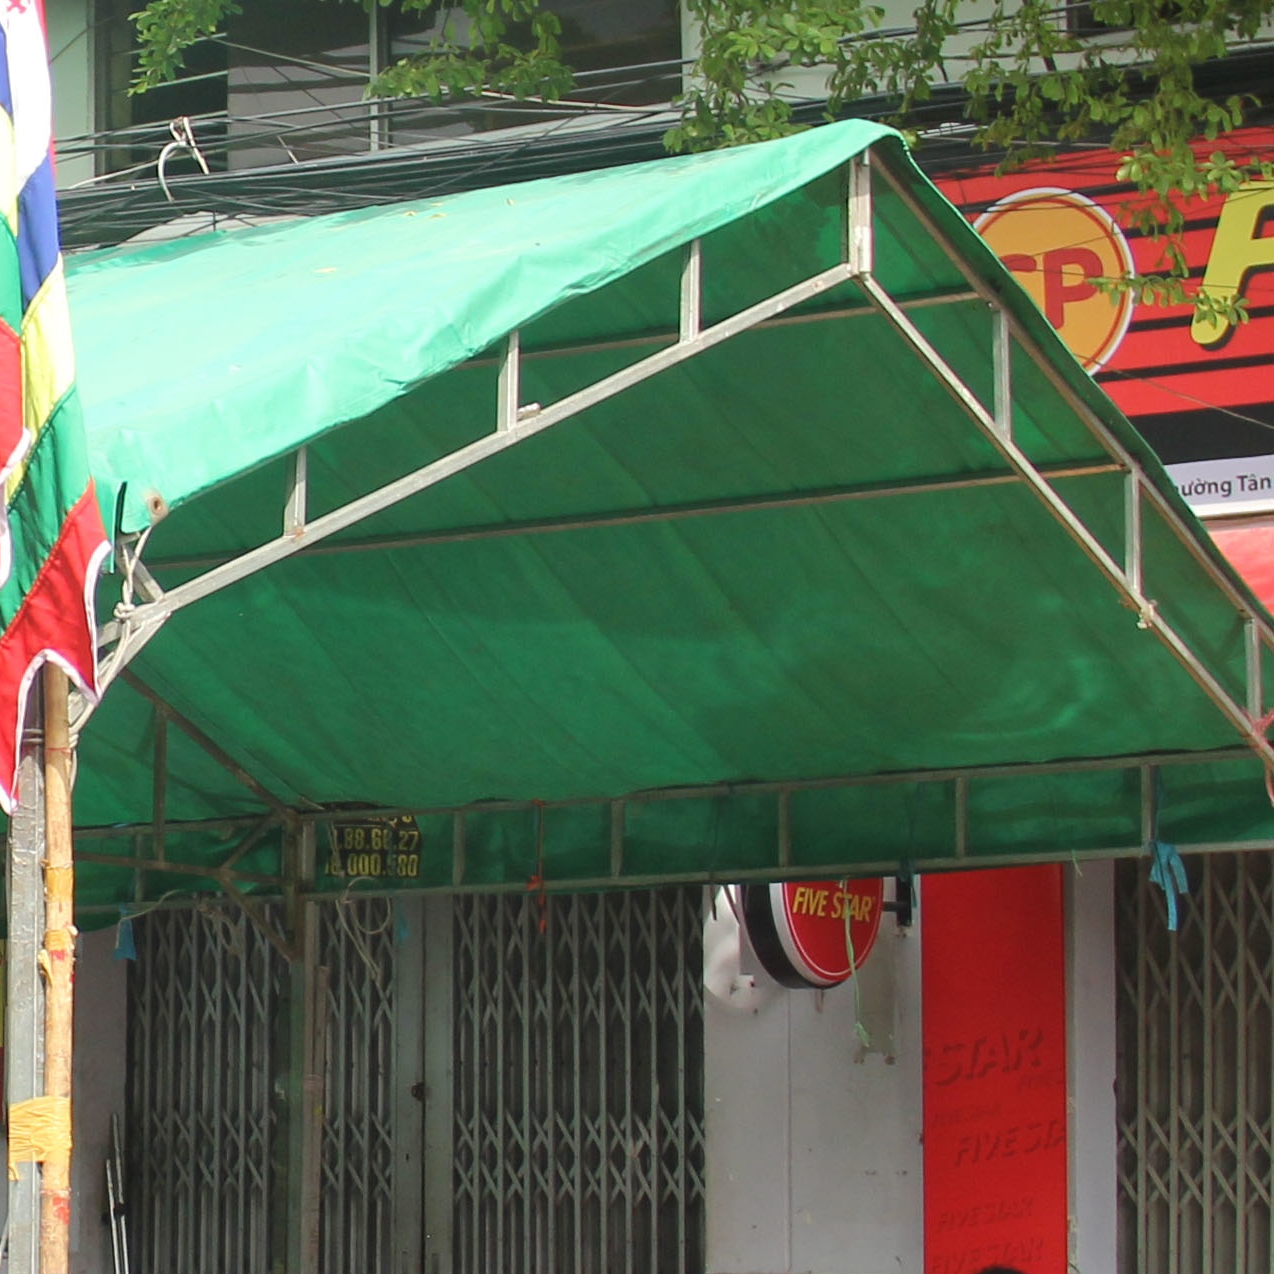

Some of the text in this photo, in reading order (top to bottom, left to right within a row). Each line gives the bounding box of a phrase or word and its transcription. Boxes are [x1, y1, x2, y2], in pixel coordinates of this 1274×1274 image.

[1179, 474, 1271, 498] ường Tân
[792, 886, 872, 922] FIVE STAR
